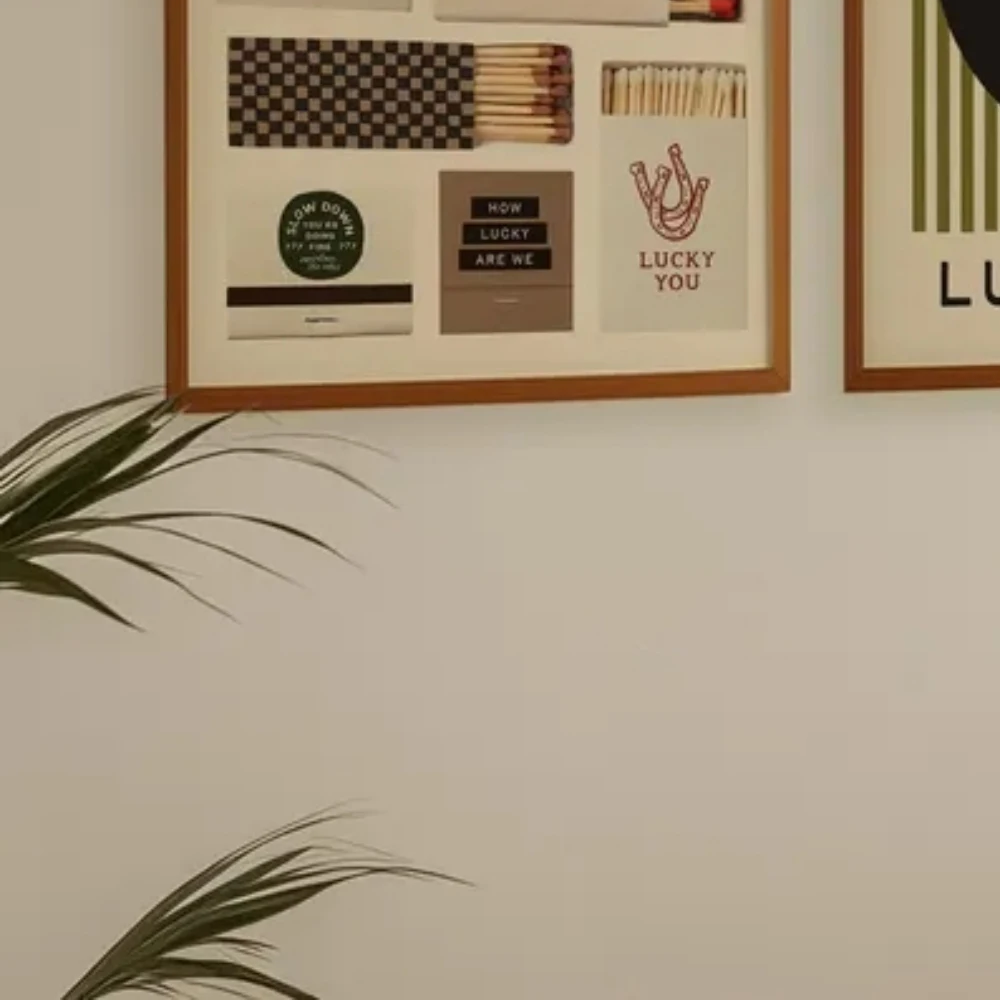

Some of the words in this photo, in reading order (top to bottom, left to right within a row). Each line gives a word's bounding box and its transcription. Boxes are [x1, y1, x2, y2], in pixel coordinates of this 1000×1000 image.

[487, 201, 522, 214] HOW
[286, 201, 317, 236] SLOW
[321, 201, 356, 237] DOWN
[480, 227, 530, 241] LUCKY
[475, 253, 506, 266] ARE
[511, 252, 534, 266] WE
[639, 251, 716, 269] LUCKY
[654, 273, 701, 292] YOU
